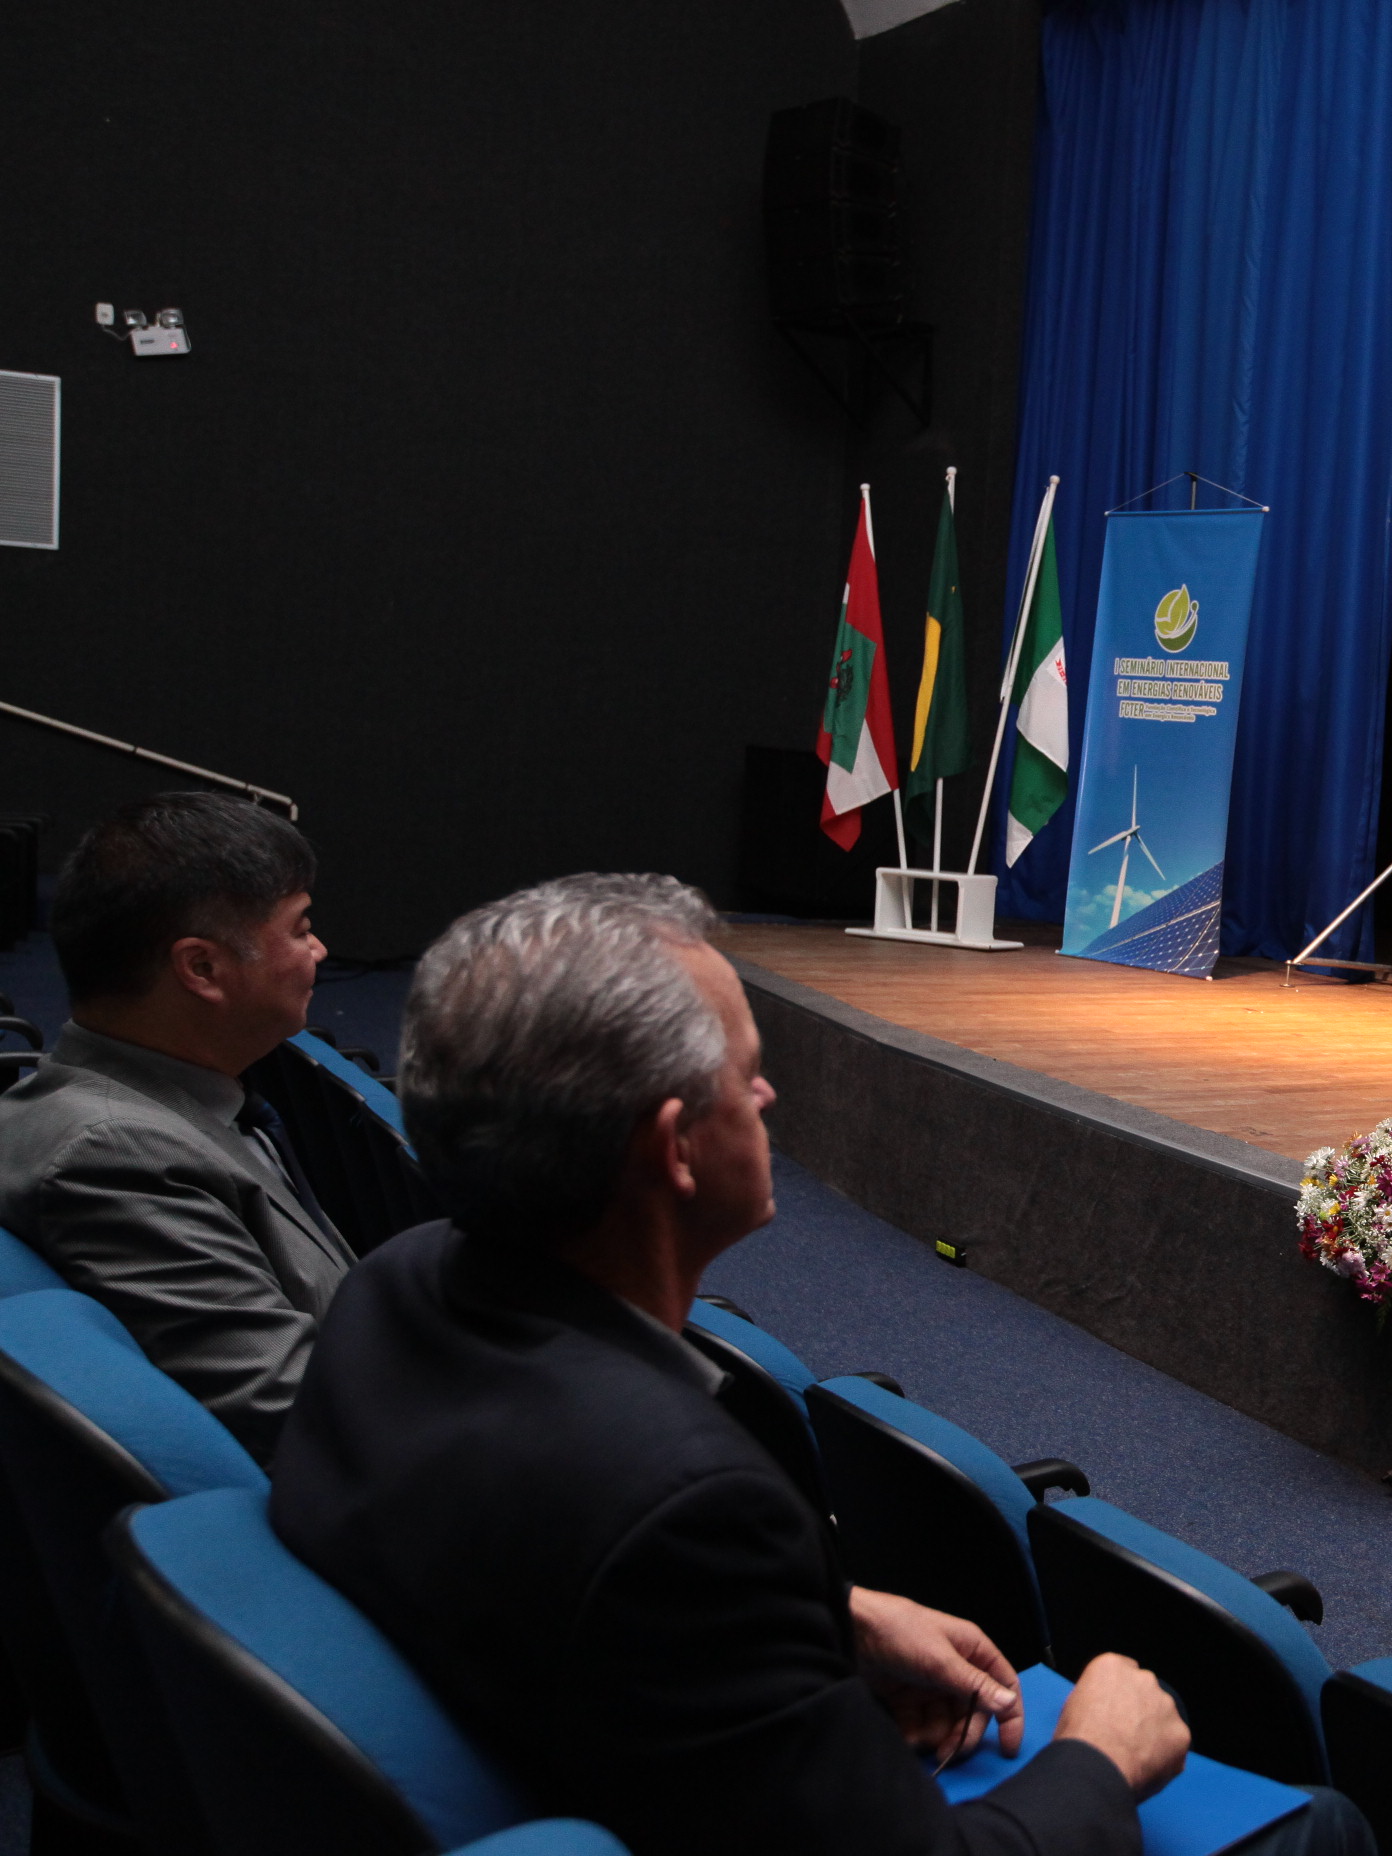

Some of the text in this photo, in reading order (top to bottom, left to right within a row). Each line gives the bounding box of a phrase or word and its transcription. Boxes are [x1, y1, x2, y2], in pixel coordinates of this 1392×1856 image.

[1120, 657, 1165, 677] SEMINÁRIO
[1166, 660, 1230, 680] INTERNACIONAL
[1117, 680, 1223, 702] EM ENERGIAS RENOVÁVEIS
[1119, 701, 1144, 718] FCTER
